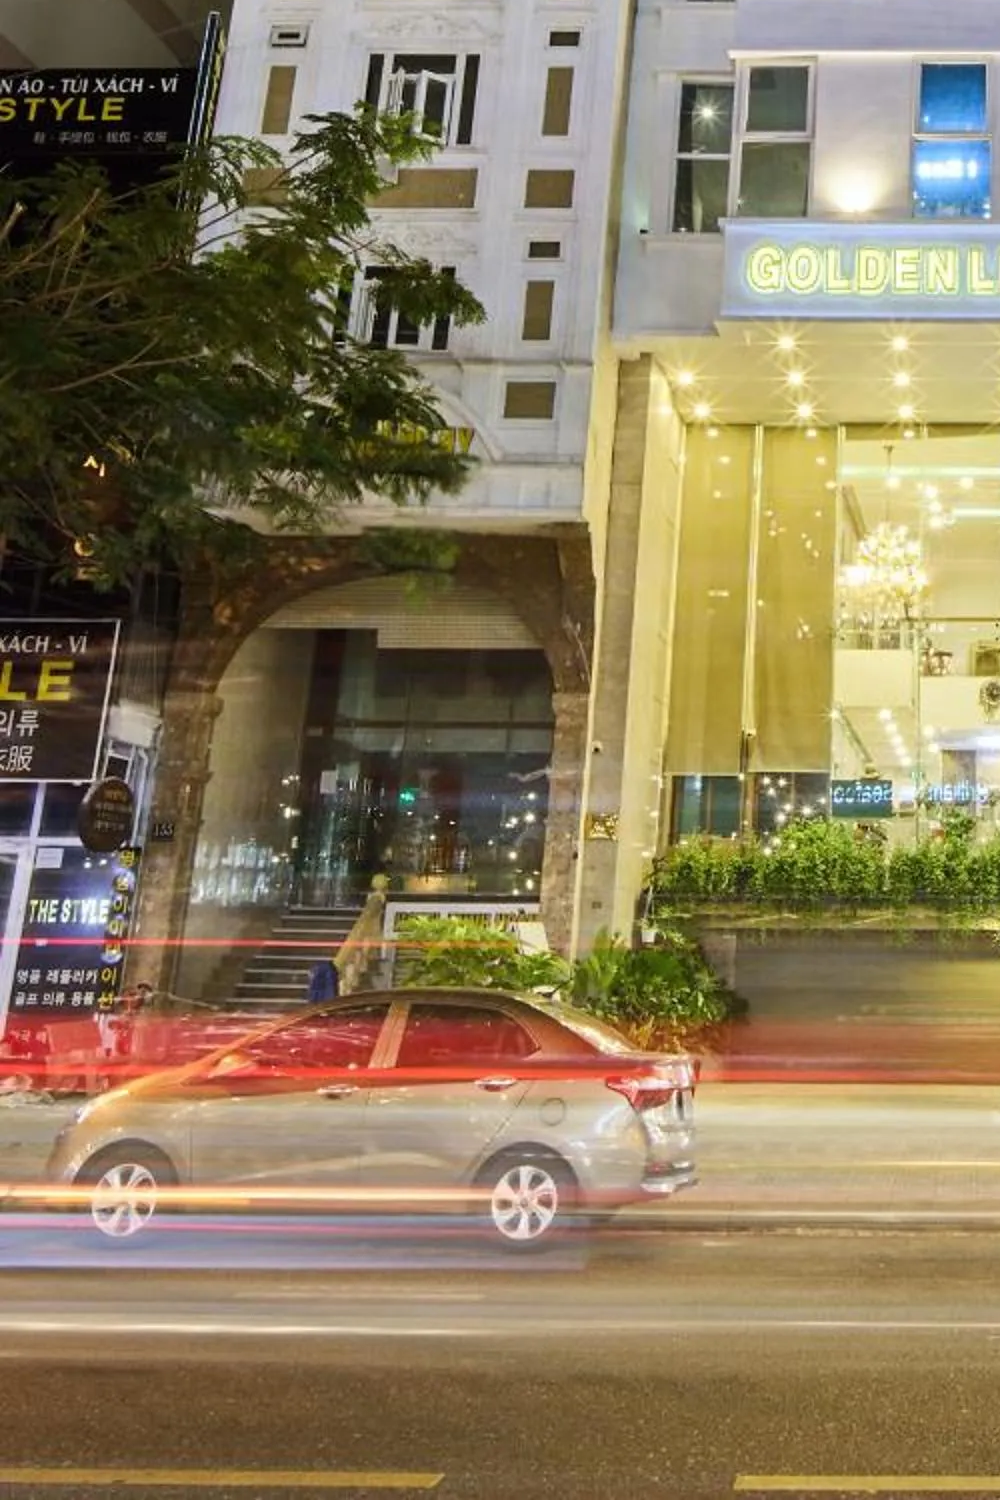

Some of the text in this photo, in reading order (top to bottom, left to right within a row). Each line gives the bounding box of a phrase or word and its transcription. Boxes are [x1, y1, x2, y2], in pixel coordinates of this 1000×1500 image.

[93, 74, 145, 94] XÁCH
[0, 97, 126, 121] STYLE
[747, 245, 959, 294] GOLDEN
[30, 898, 111, 925] THE STYLE
